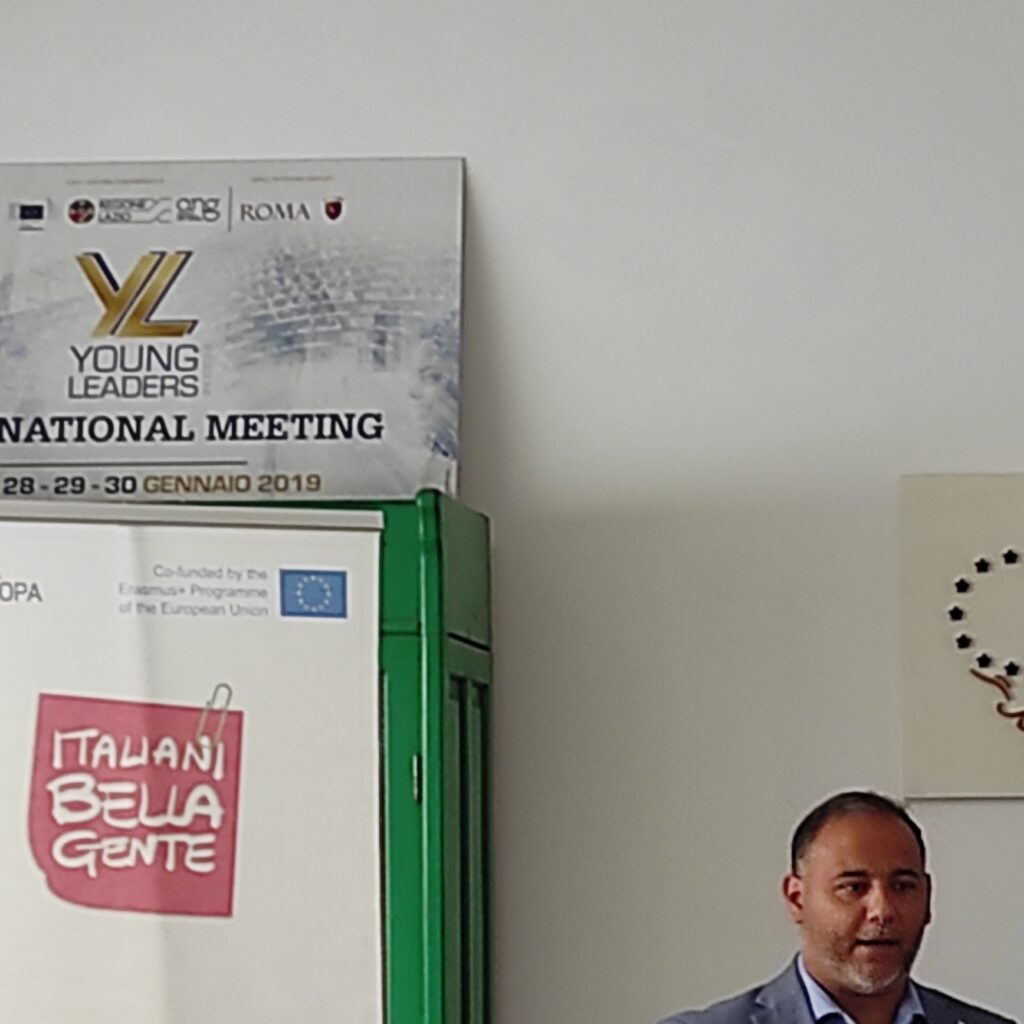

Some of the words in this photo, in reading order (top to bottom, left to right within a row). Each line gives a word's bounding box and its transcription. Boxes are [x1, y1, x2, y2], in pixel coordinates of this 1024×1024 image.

[240, 203, 310, 221] ROMA
[70, 344, 200, 373] YOUNG
[68, 375, 199, 399] LEADERS
[205, 413, 384, 441] MEETING
[3, 476, 35, 495] 28
[53, 476, 86, 495] 29
[104, 476, 137, 495] 30
[142, 475, 250, 493] GENNAIO
[258, 474, 322, 492] 2019
[190, 583, 268, 599] Programme
[229, 603, 269, 616] Union
[46, 773, 225, 829] BELLA
